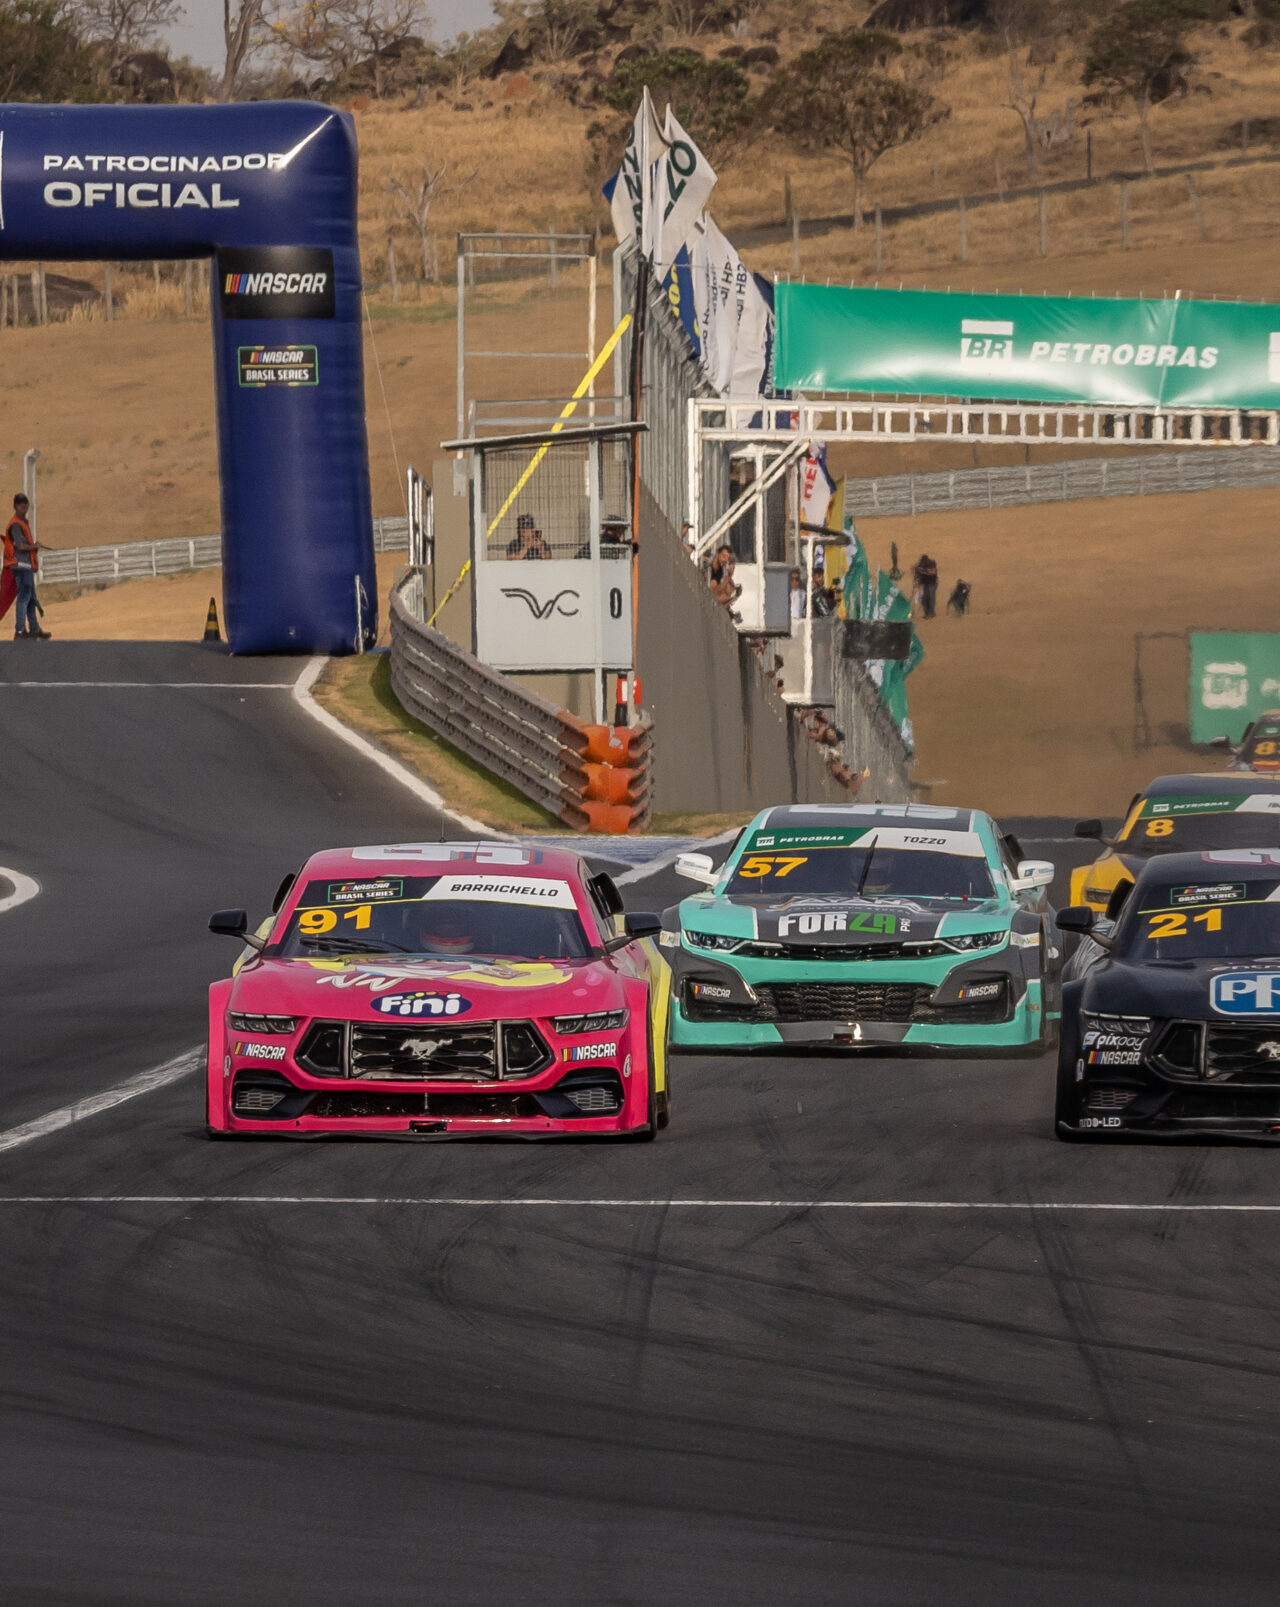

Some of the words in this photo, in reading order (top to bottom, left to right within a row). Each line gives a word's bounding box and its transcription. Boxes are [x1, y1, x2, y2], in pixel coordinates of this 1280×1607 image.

[43, 153, 285, 173] PATROCINADOR
[44, 181, 240, 209] OFICIAL
[245, 272, 327, 295] NASCAR
[261, 351, 304, 364] NASCAR
[1029, 341, 1219, 369] PETROBRAS
[246, 370, 276, 381] BRASIL
[278, 369, 309, 380] SERIES
[609, 587, 622, 619] 0
[1145, 818, 1175, 837] 8
[779, 835, 845, 843] PETROBRAS
[903, 835, 947, 845] TOZZO
[739, 857, 808, 877] 57
[335, 891, 364, 901] BRASIL
[366, 889, 394, 899] SERIES
[353, 882, 391, 891] NASCAR
[450, 883, 559, 897] BARRICHELLO
[1178, 893, 1208, 902] BRASIL
[1209, 892, 1238, 901] SERIES
[299, 905, 373, 935] 91
[778, 911, 896, 937] FORZA
[1148, 908, 1223, 939] 21
[702, 985, 731, 998] NASCAR
[968, 984, 998, 997] NASCAR
[380, 993, 461, 1015] Fini
[576, 1042, 617, 1060] NASCAR
[1096, 1033, 1148, 1051] pixpay
[245, 1043, 286, 1061] NASCAR
[1100, 1051, 1141, 1065] NASCAR
